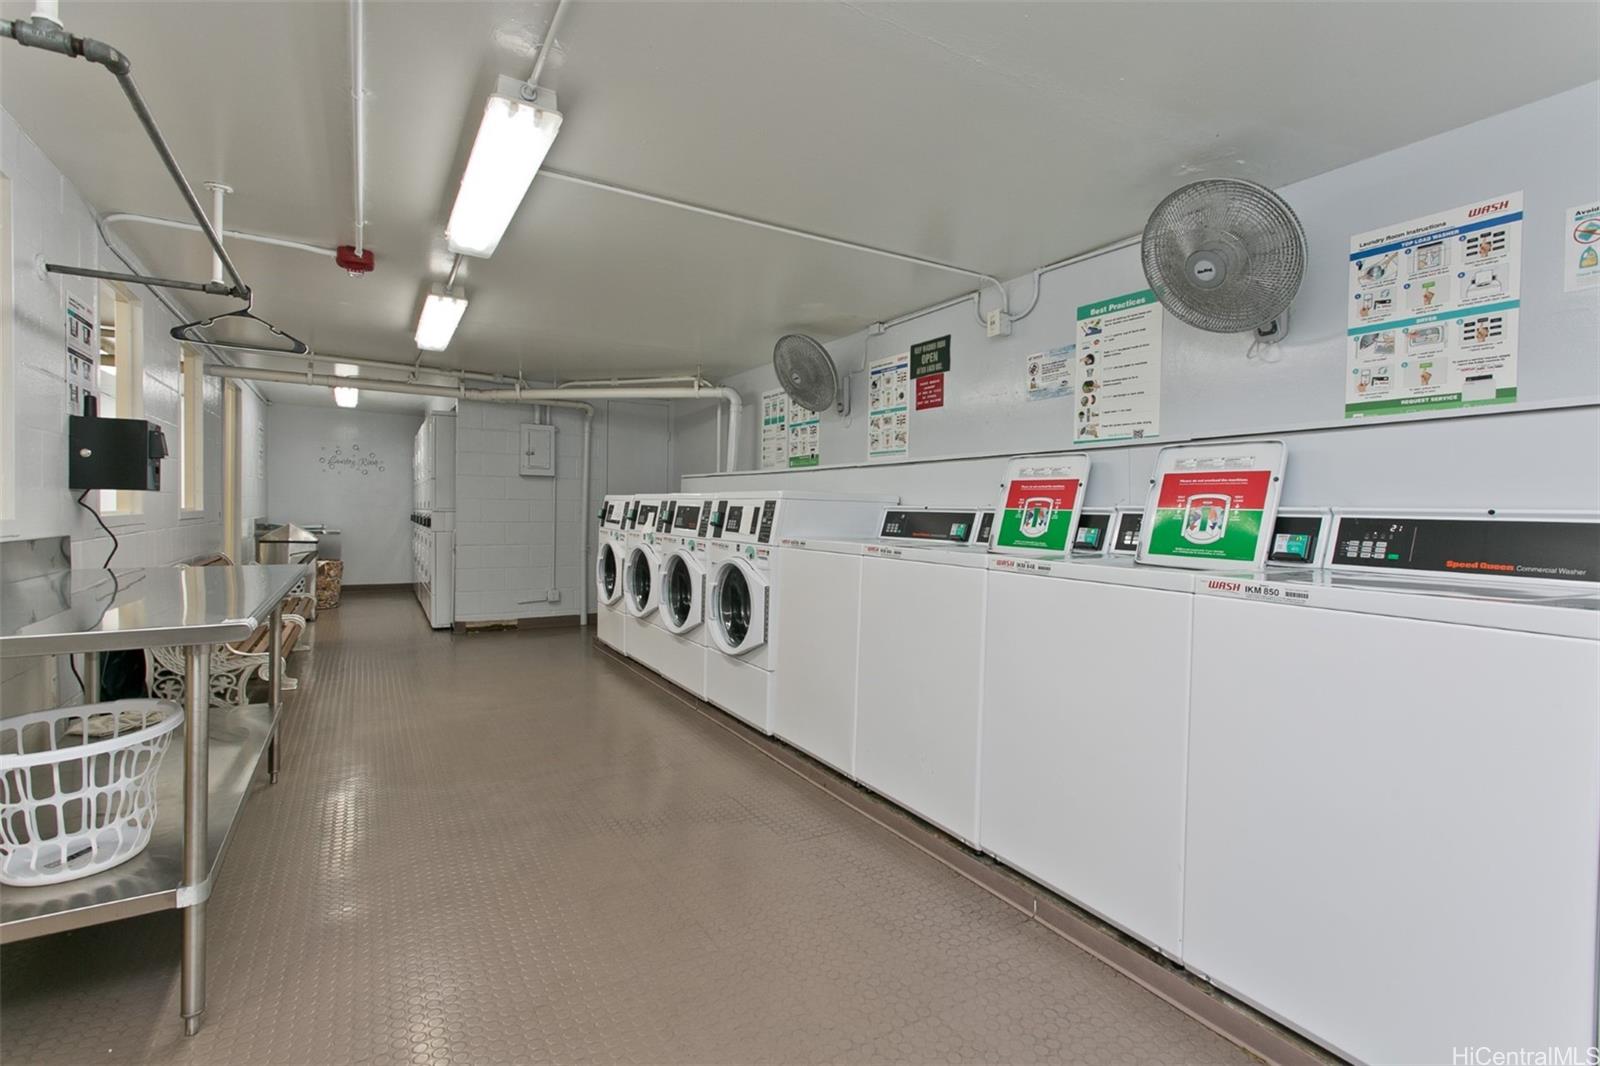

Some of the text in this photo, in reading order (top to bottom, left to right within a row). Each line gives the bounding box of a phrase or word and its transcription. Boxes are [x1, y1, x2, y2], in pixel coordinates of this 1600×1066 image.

[1468, 200, 1509, 218] WASH
[1359, 220, 1447, 249] Laundry Room Instructions
[1400, 229, 1461, 249] TOP LOAD WASHER
[1090, 297, 1146, 316] Best Practices
[921, 351, 939, 365] OPEN
[1401, 394, 1458, 405] REQUEST SERVICE
[1445, 559, 1588, 576] Speed Queen Commercial Washer
[1208, 580, 1280, 597] WASH IKM 850
